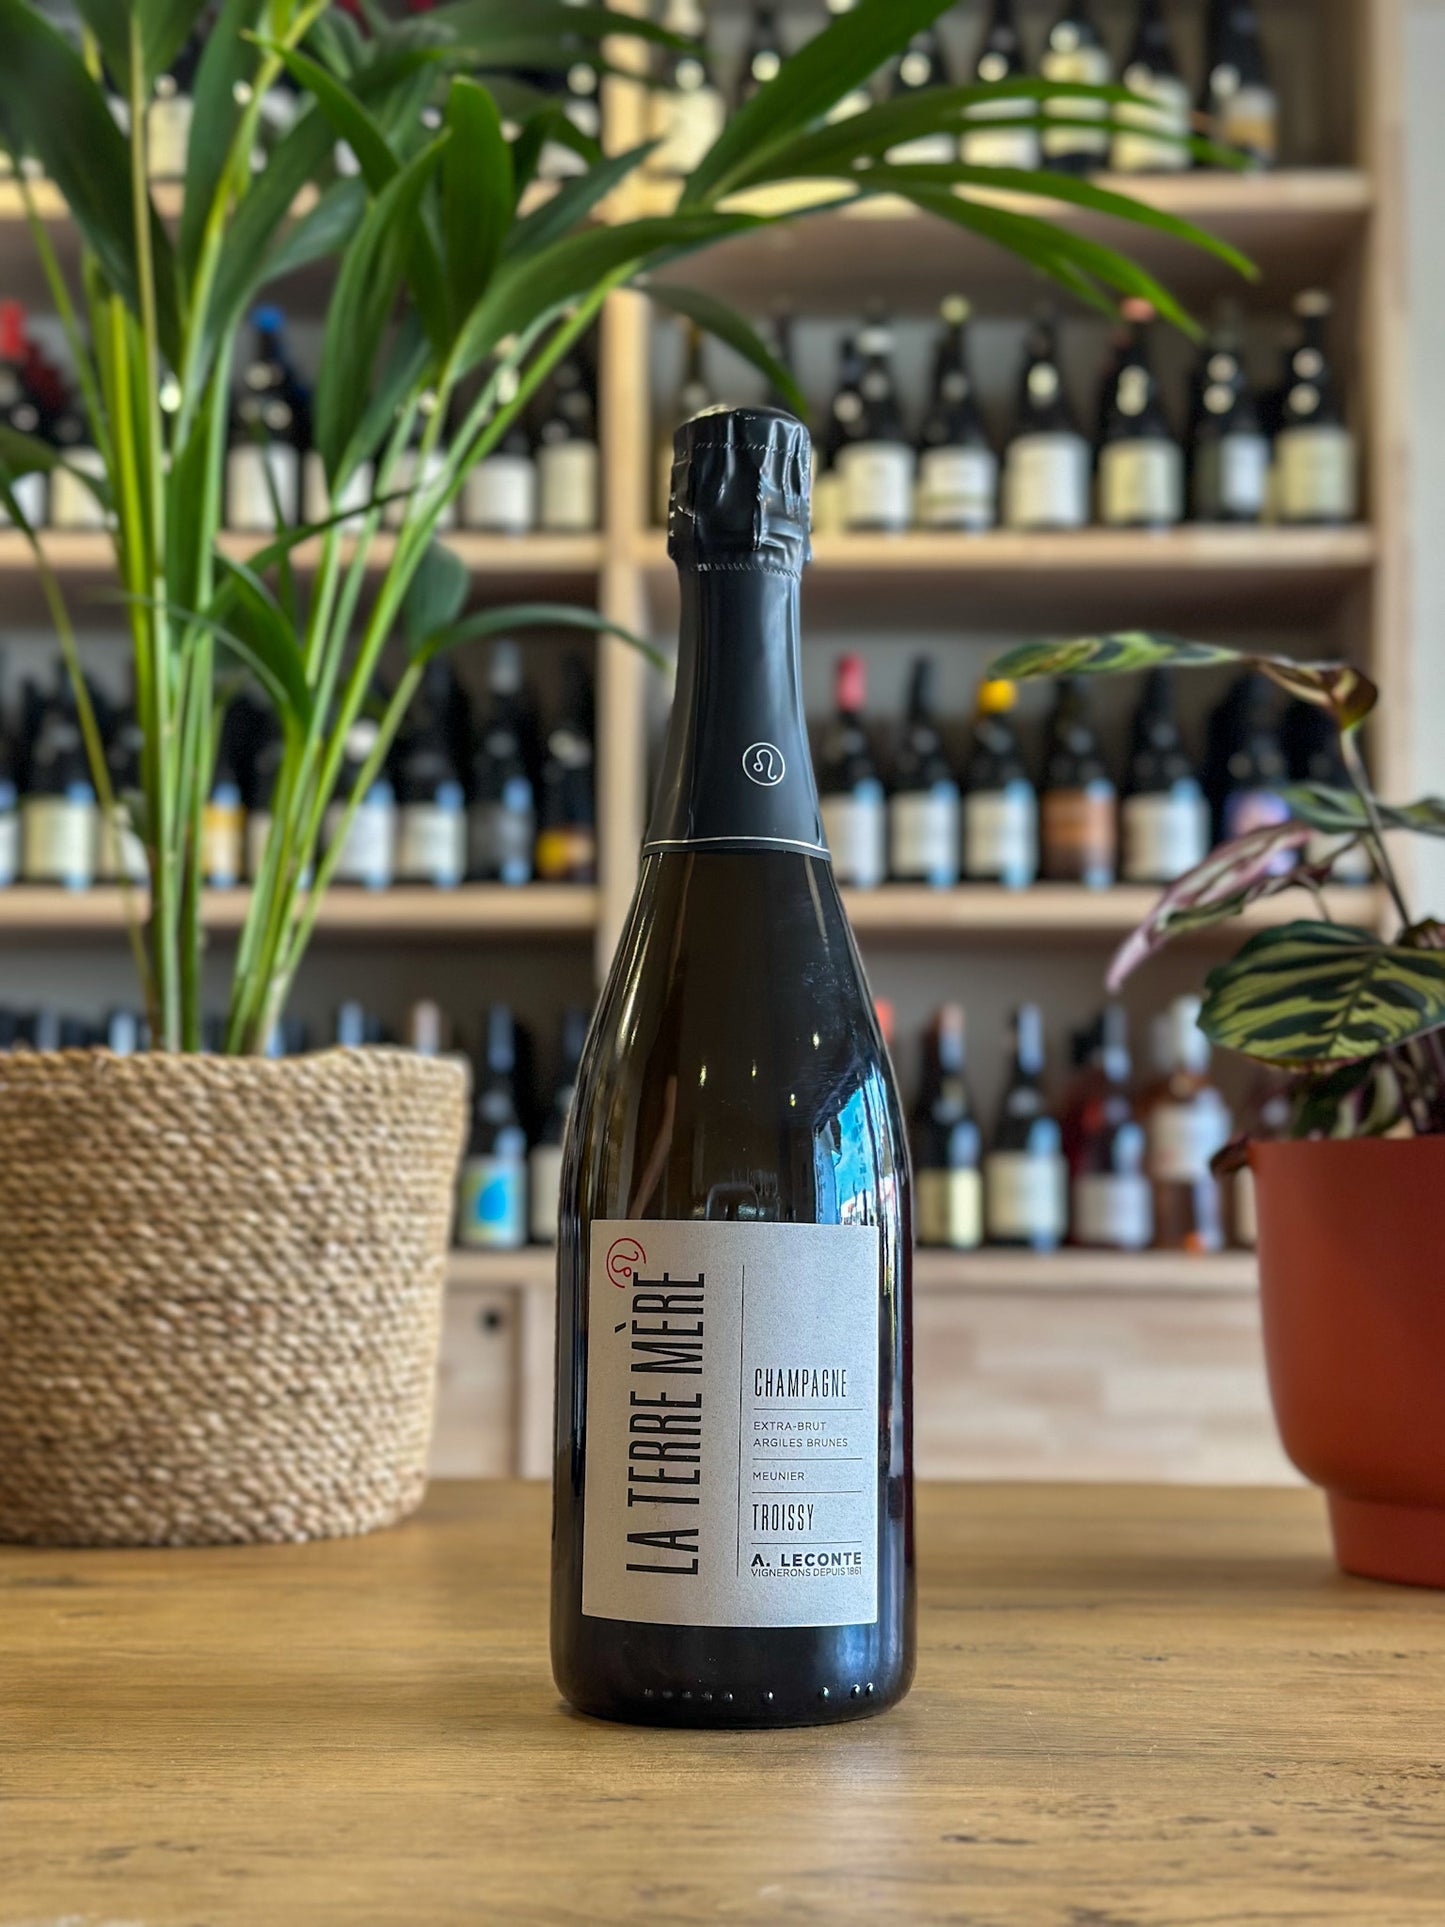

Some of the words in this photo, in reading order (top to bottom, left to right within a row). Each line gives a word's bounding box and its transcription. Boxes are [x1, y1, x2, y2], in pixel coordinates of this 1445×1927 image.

[614, 1272, 705, 1375] MÈRE
[754, 1368, 847, 1398] CHAMPAGNE
[753, 1421, 827, 1432] EXTRA-BRUT
[627, 1390, 702, 1507] TERRE
[753, 1438, 803, 1448] ARGILES
[806, 1438, 848, 1448] BRUNES
[752, 1471, 805, 1481] MEUNIER
[752, 1504, 814, 1531] TROISSY
[626, 1528, 699, 1575] LA
[751, 1553, 771, 1567] A.
[781, 1552, 862, 1567] LECONTE
[751, 1567, 811, 1578] VIGNERONS
[812, 1567, 846, 1577] DEPUIS
[846, 1566, 862, 1576] 1861
